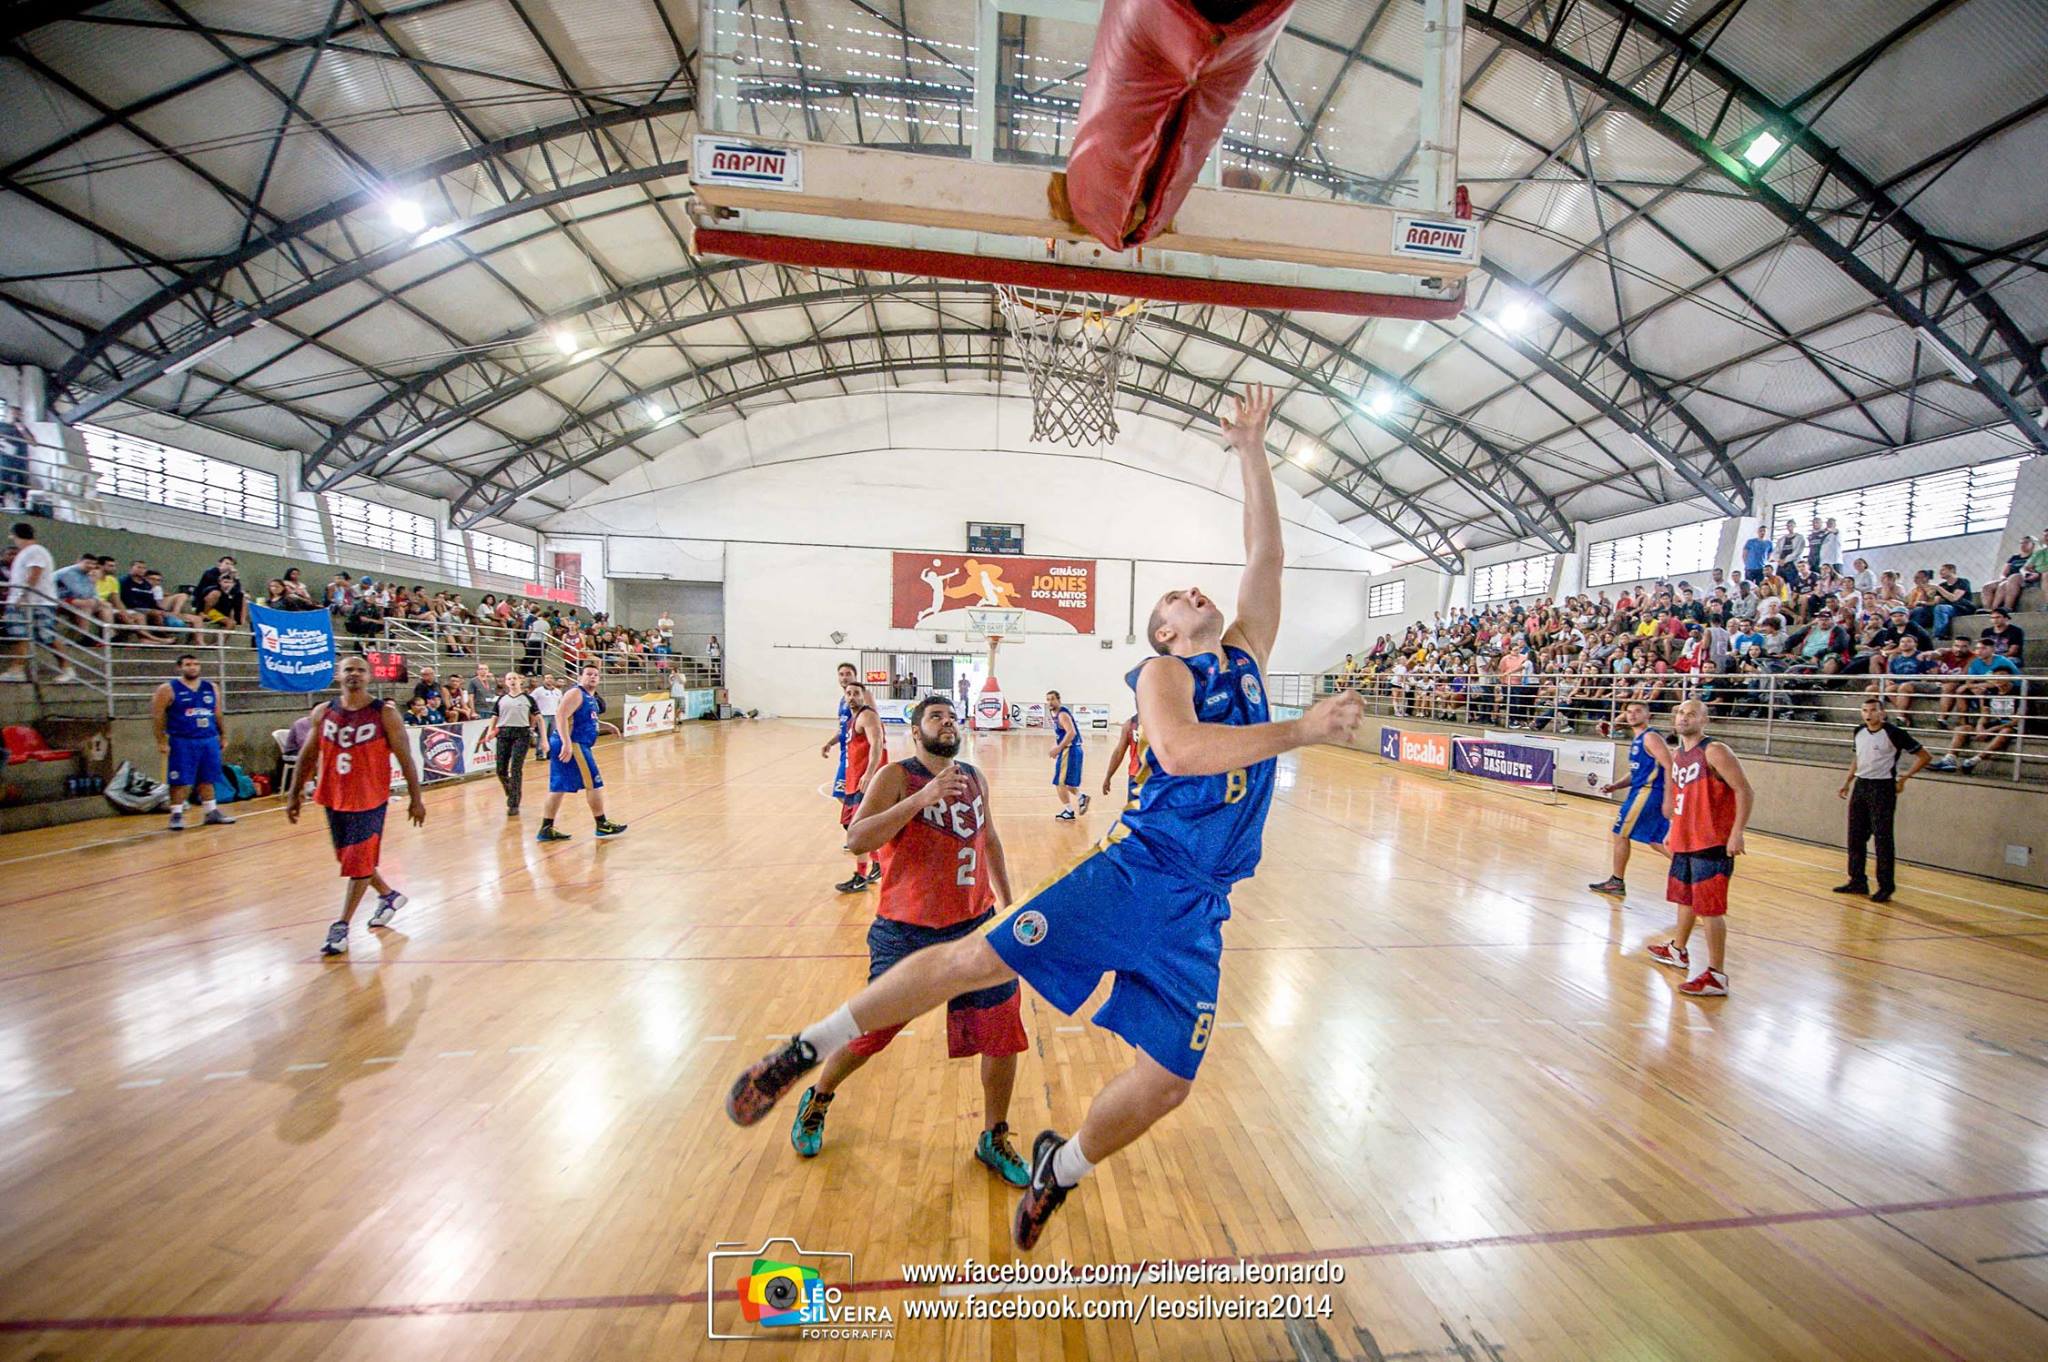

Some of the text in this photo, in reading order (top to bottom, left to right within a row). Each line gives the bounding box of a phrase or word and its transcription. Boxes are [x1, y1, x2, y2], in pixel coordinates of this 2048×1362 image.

[713, 152, 785, 175] RAPINI
[1406, 228, 1465, 249] RAPINI
[1049, 565, 1088, 576] GINÁSIO
[1031, 575, 1087, 591] JONES
[1031, 590, 1087, 600] DOS SANTOS
[1058, 599, 1088, 608] NEVES
[323, 719, 377, 748] RED
[336, 752, 352, 775] 6
[1483, 757, 1533, 780] BASQUETE
[1672, 762, 1700, 789] RED
[1674, 793, 1685, 815] 3
[956, 847, 976, 886] 2
[1190, 1013, 1214, 1051] 8
